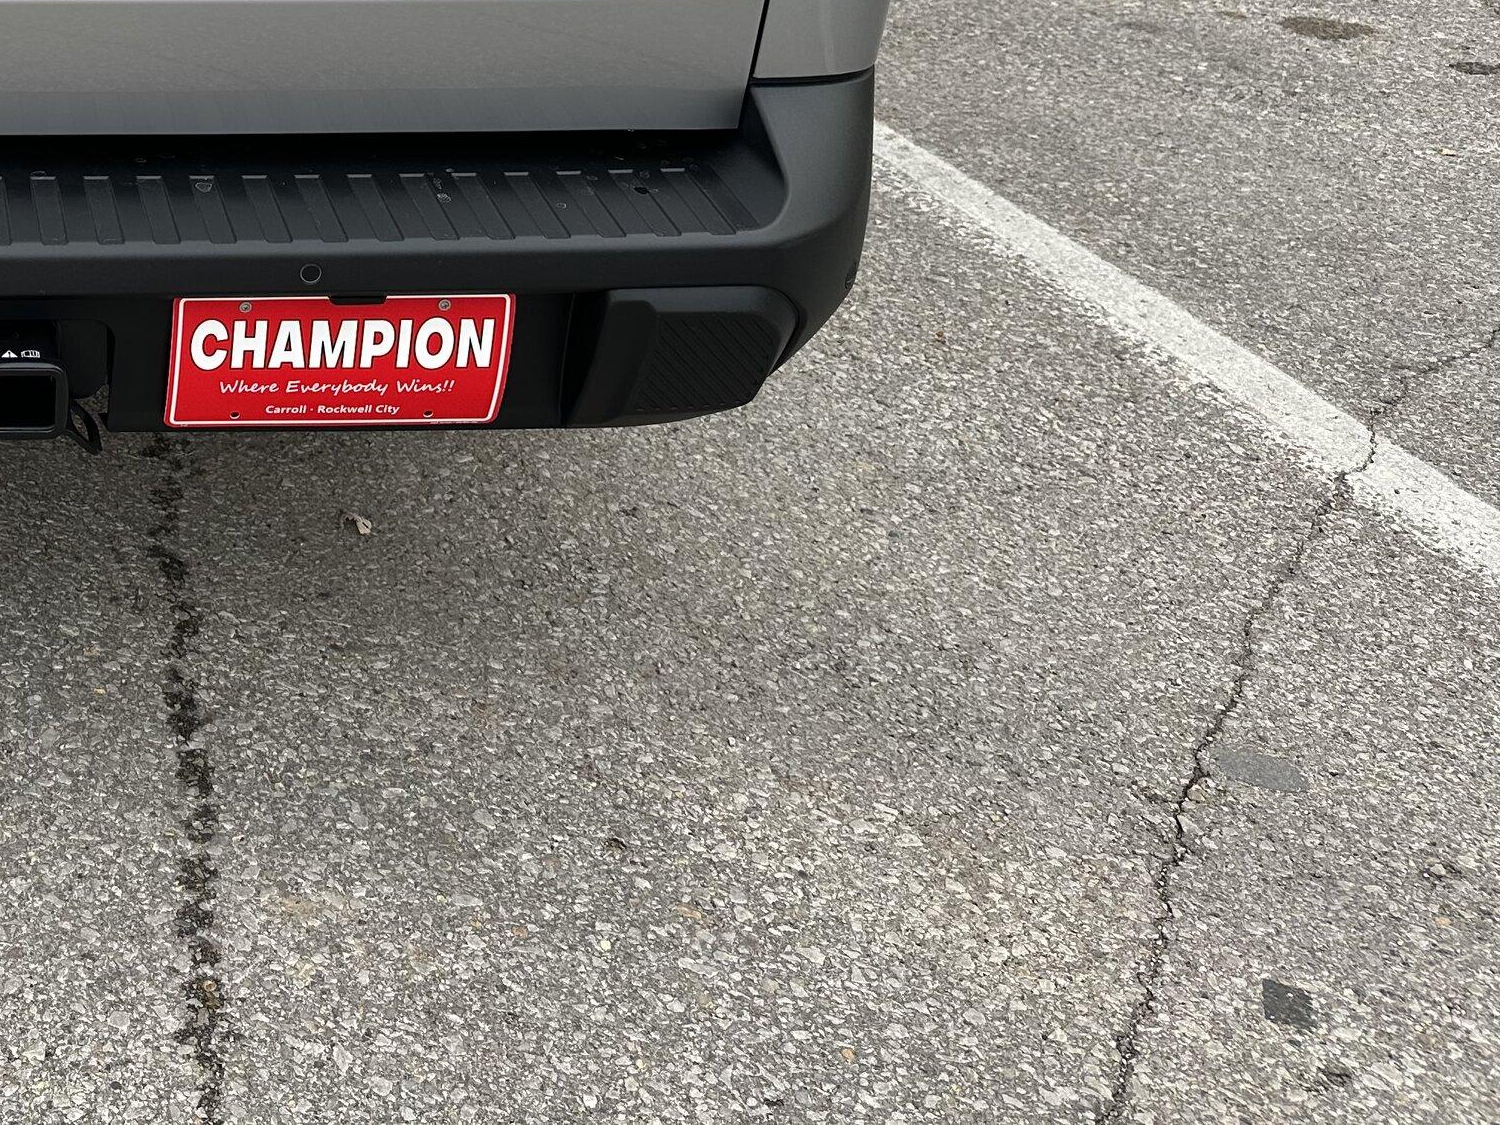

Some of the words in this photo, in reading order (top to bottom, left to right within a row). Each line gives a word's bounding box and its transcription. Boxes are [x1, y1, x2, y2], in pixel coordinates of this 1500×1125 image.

[189, 317, 497, 371] CHAMPION
[219, 379, 280, 394] Where
[285, 379, 389, 396] Everybody
[396, 379, 456, 394] Wins!!
[265, 404, 307, 414] Carroll
[317, 404, 372, 414] Rockwell
[375, 404, 401, 416] City
